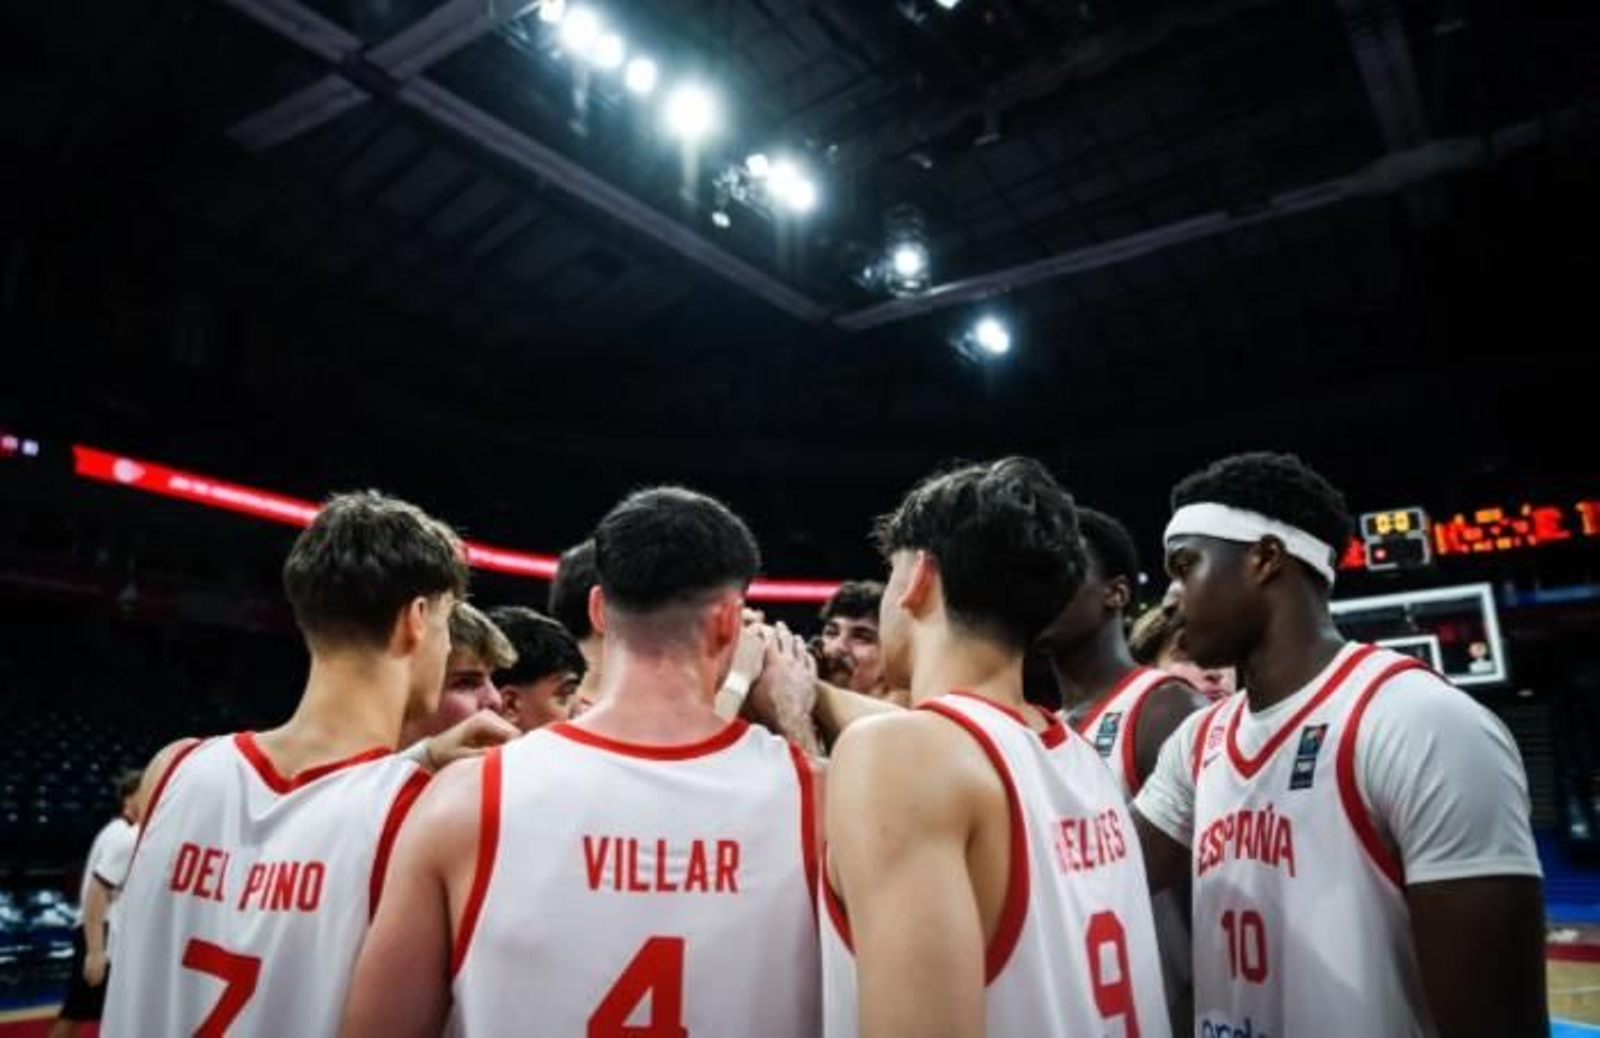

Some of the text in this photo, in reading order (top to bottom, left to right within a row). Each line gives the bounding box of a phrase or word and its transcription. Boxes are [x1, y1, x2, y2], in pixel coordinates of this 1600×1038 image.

[169, 841, 326, 913] DEL PINO
[583, 835, 740, 894] VILLAR
[1198, 802, 1296, 878] ESPAÑA
[1085, 909, 1141, 1038] 9
[1221, 910, 1268, 985] 10
[182, 939, 261, 1038] 7
[586, 935, 688, 1038] 4
